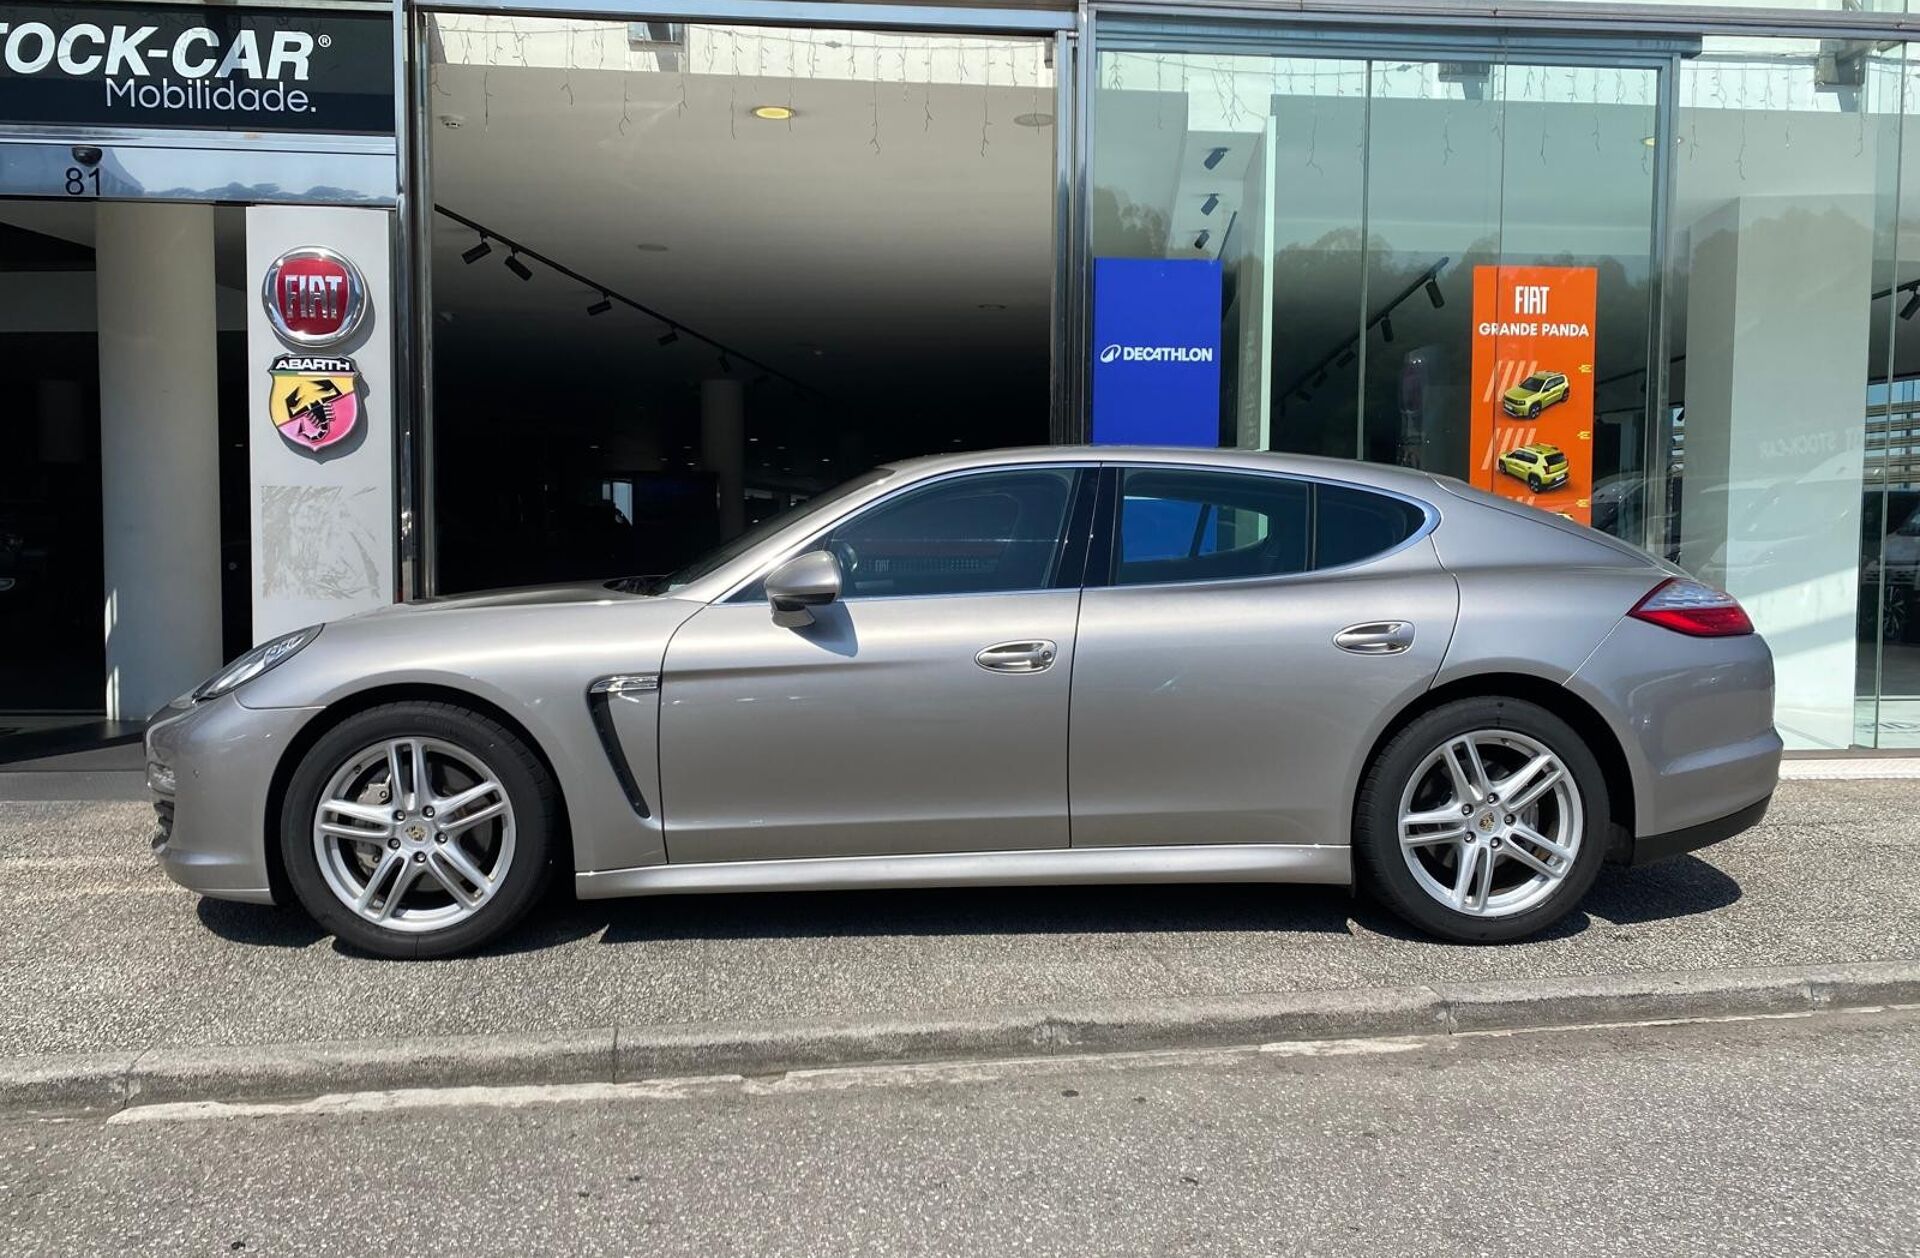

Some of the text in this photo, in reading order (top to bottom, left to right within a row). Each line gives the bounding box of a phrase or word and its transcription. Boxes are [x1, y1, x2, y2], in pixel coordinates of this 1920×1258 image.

[106, 78, 316, 112] Mobilidade.
[65, 167, 101, 196] 81
[285, 274, 342, 319] FIAT
[1514, 285, 1550, 315] FIAT
[1478, 322, 1590, 337] GRANDE PANDA
[275, 358, 350, 371] ABARTH
[1122, 346, 1213, 362] DECATHLON
